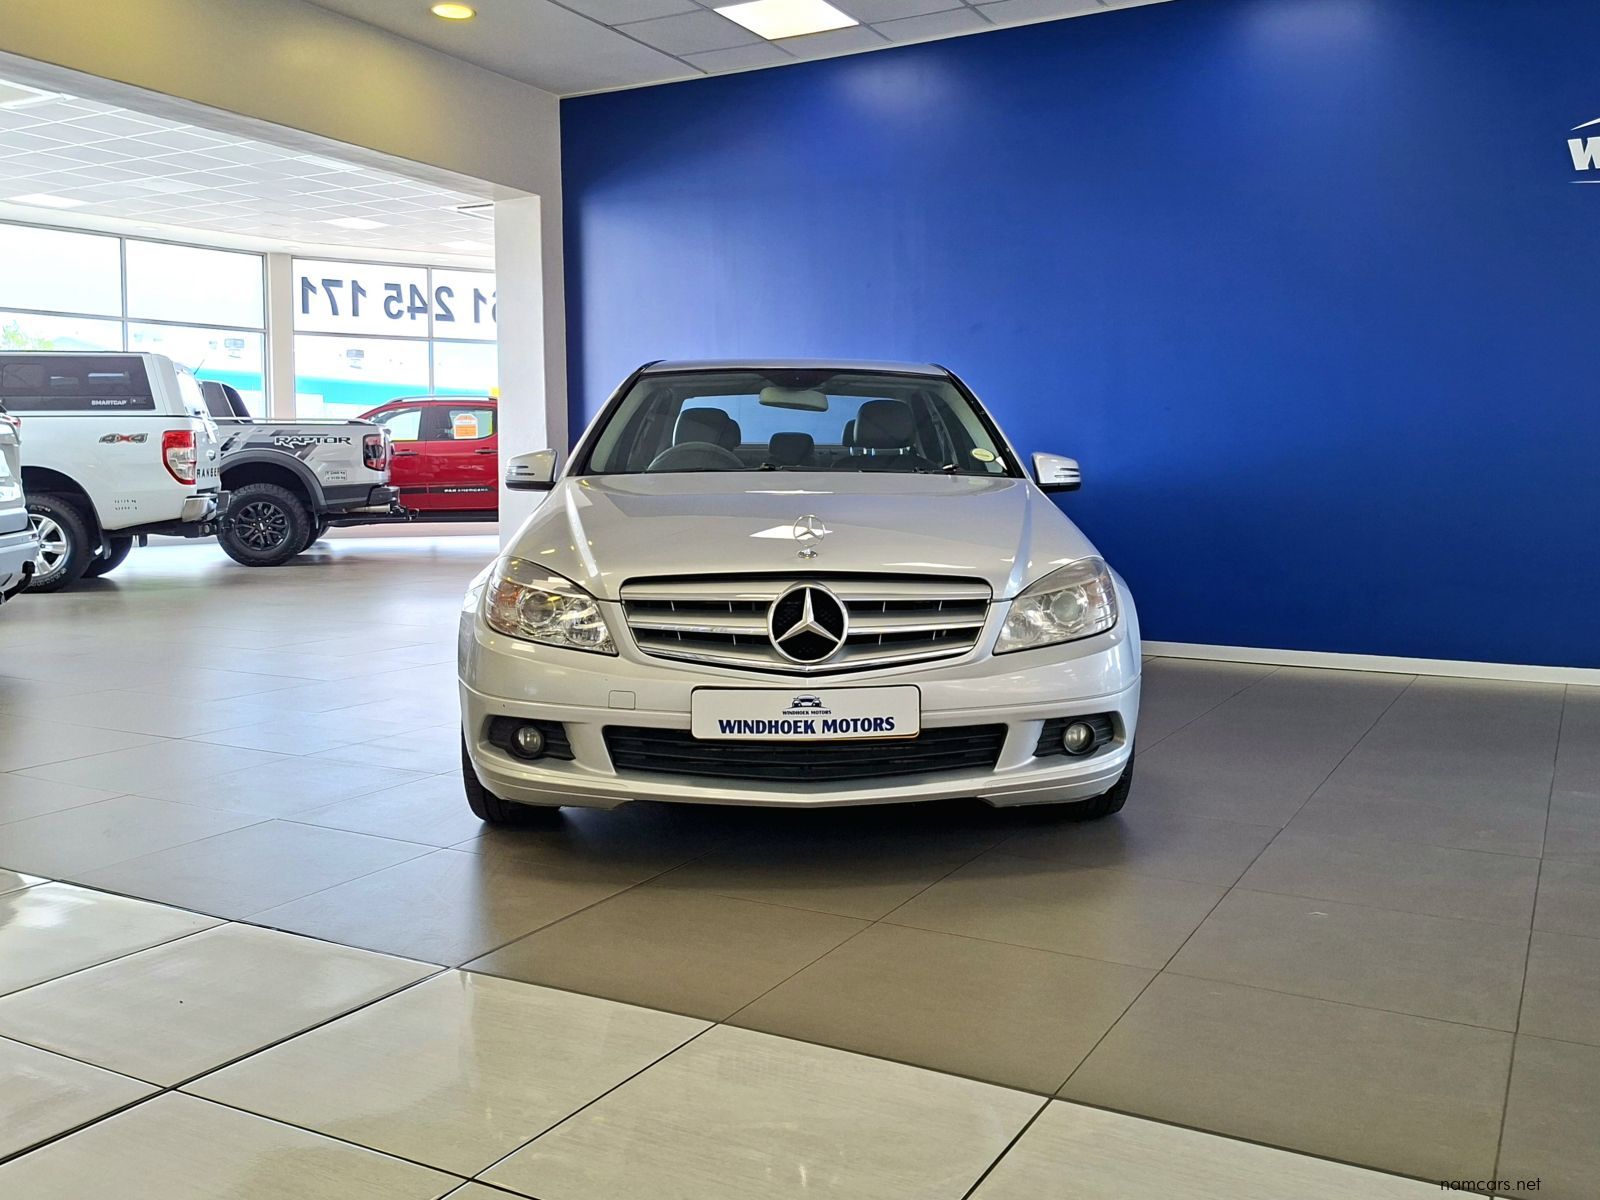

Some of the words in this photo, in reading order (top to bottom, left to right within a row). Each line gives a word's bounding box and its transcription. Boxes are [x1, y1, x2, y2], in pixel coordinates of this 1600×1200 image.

[274, 436, 352, 449] RAPTOR
[718, 719, 816, 734] WINDHOEK
[822, 716, 895, 734] MOTORS
